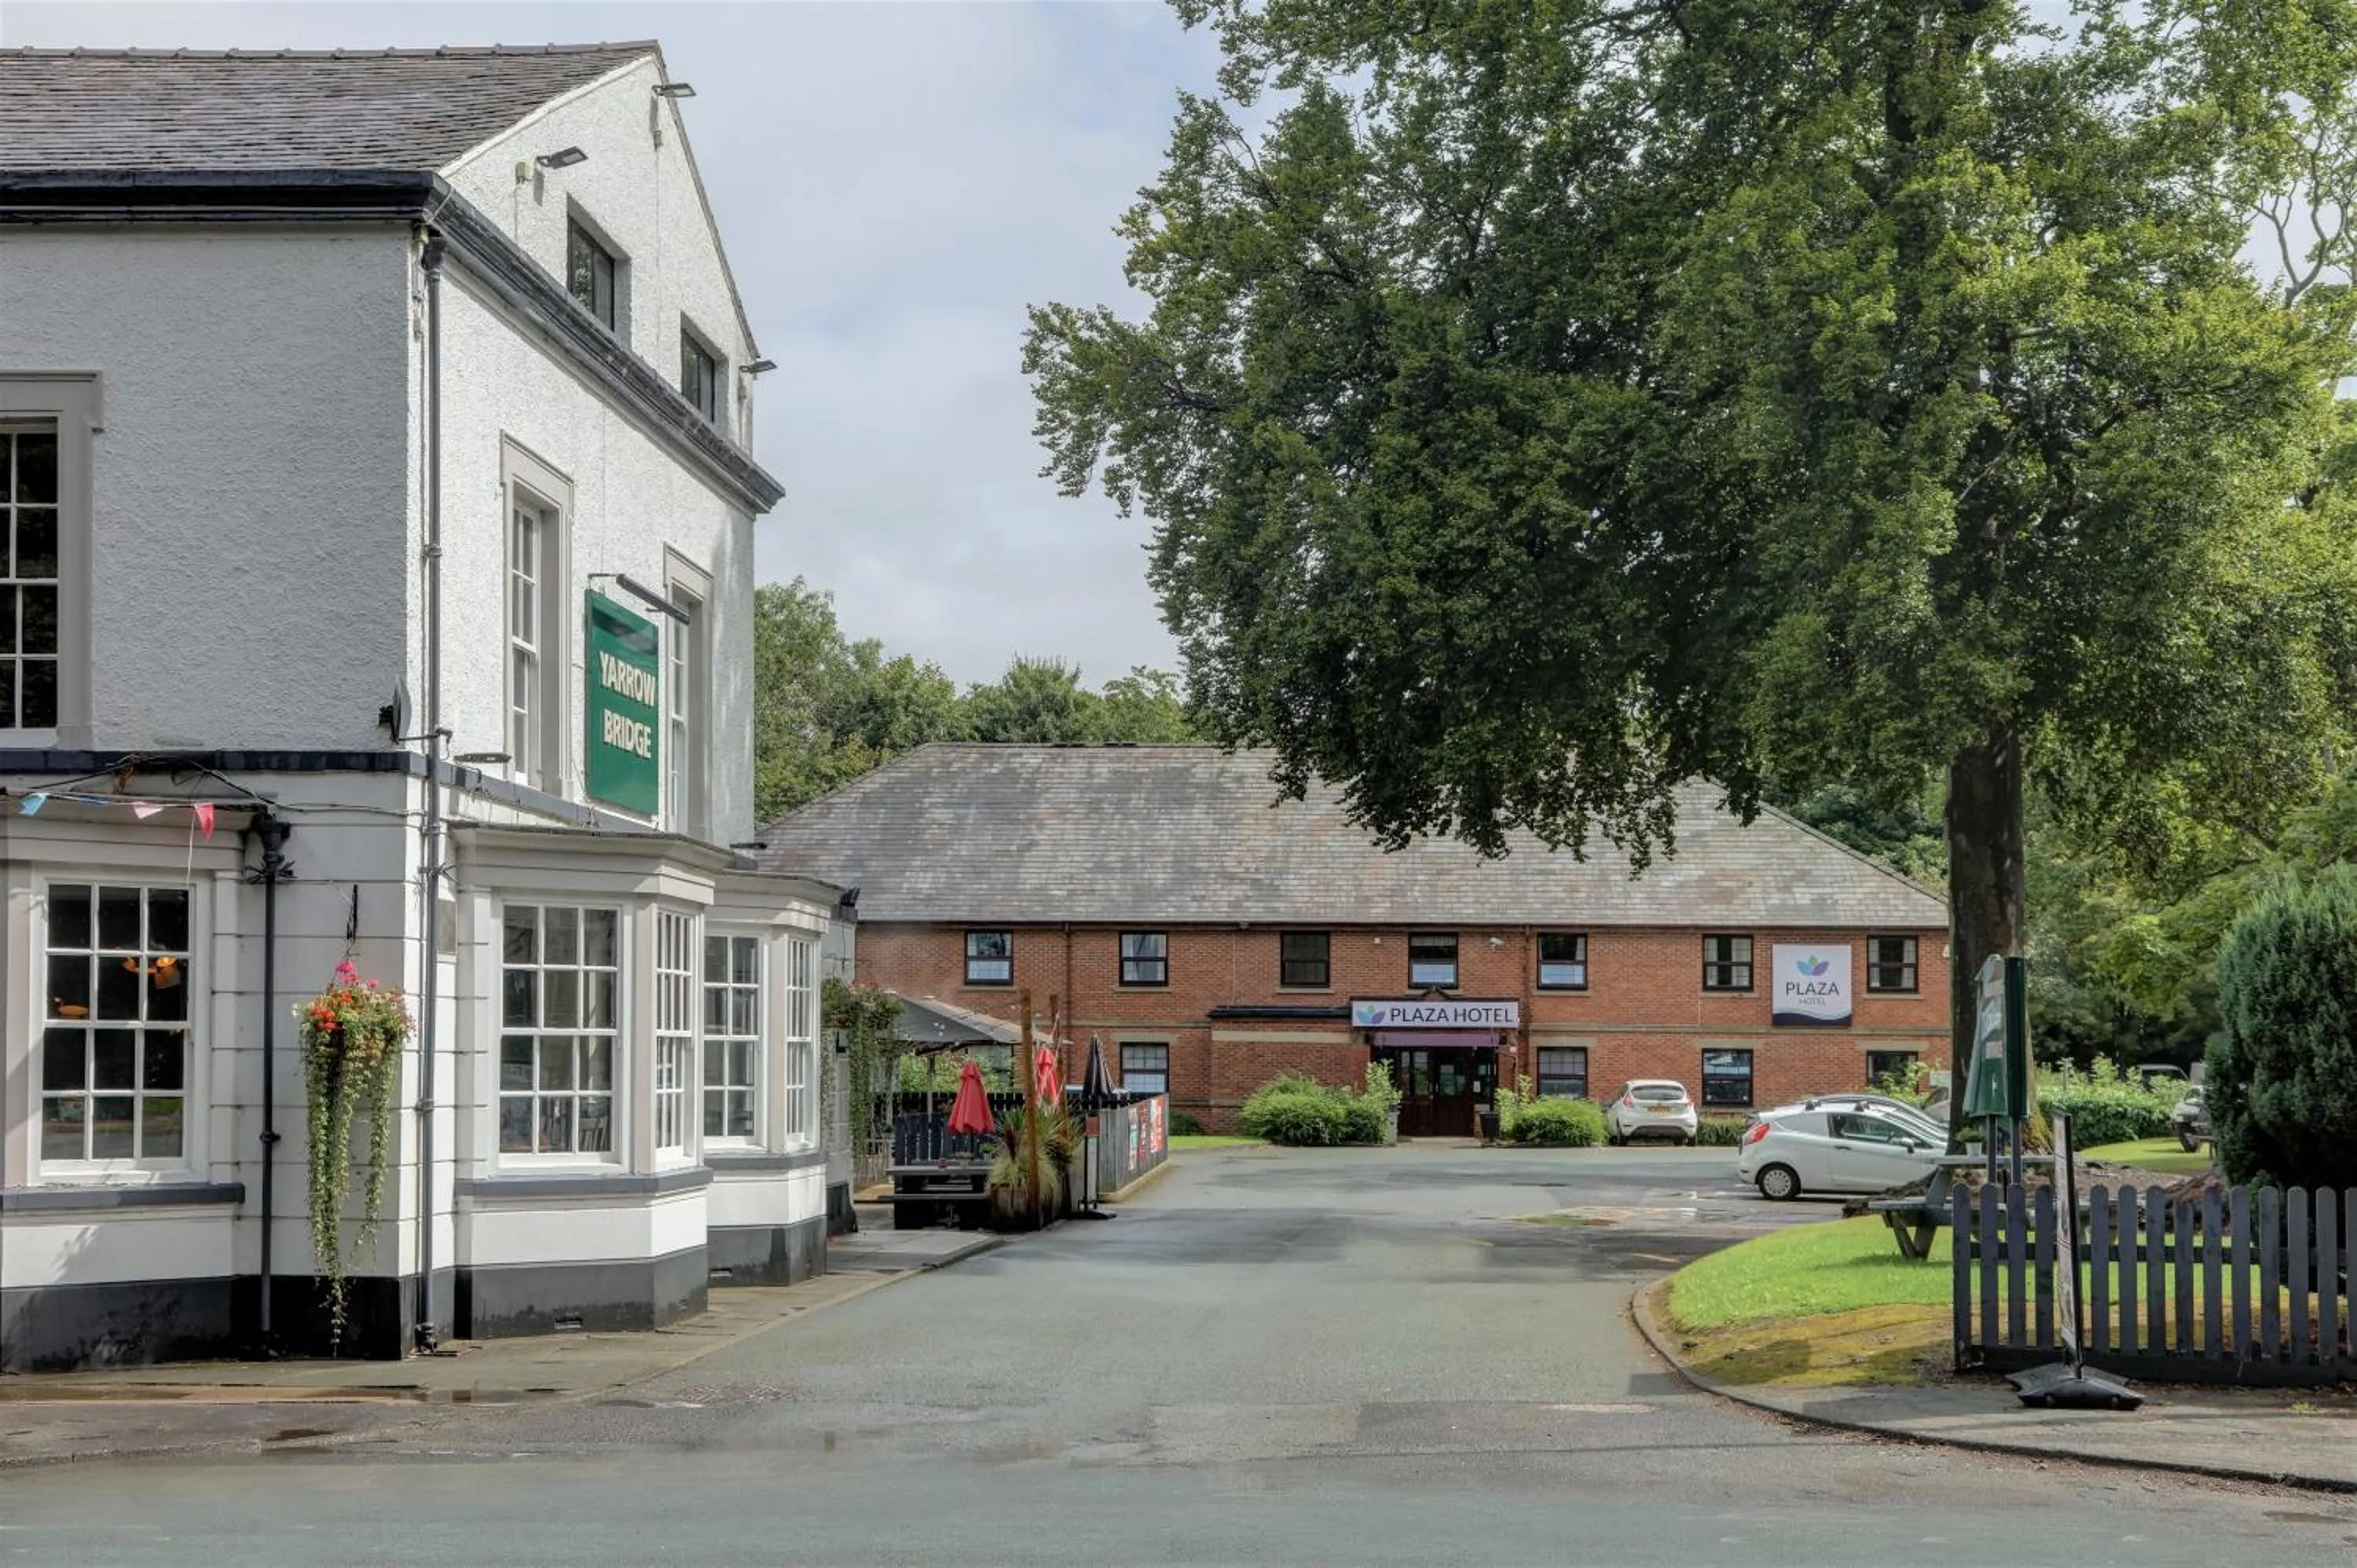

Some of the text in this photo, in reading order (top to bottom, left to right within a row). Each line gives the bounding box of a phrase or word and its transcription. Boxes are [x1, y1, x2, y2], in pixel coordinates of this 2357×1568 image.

[599, 650, 656, 706] YARROW
[603, 709, 651, 759] BRIDGE
[1786, 981, 1839, 996] PLAZA
[1390, 1007, 1514, 1023] PLAZA HOTEL
